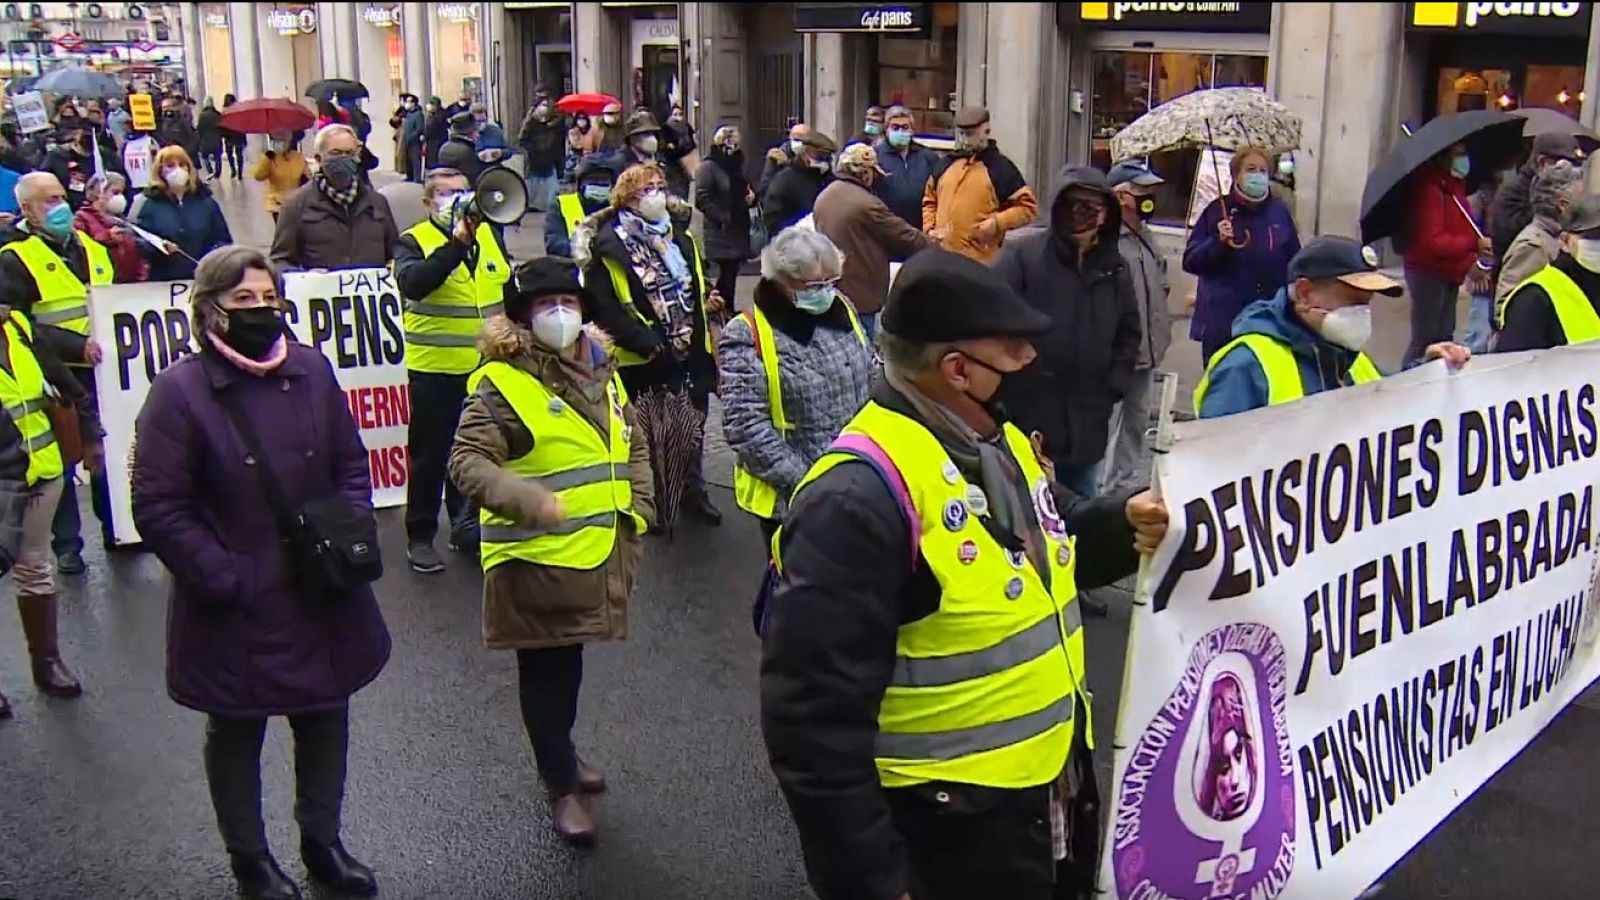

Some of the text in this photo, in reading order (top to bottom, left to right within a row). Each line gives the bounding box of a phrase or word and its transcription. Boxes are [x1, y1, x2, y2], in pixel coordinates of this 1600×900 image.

[880, 11, 912, 29] pans
[309, 291, 405, 369] PENS
[1152, 418, 1443, 613] PENSIONES
[1458, 383, 1599, 497] DIGNAS
[1294, 485, 1593, 696] FUENLABRADA
[1298, 590, 1584, 871] PENSIONISTAS EN LUCHA
